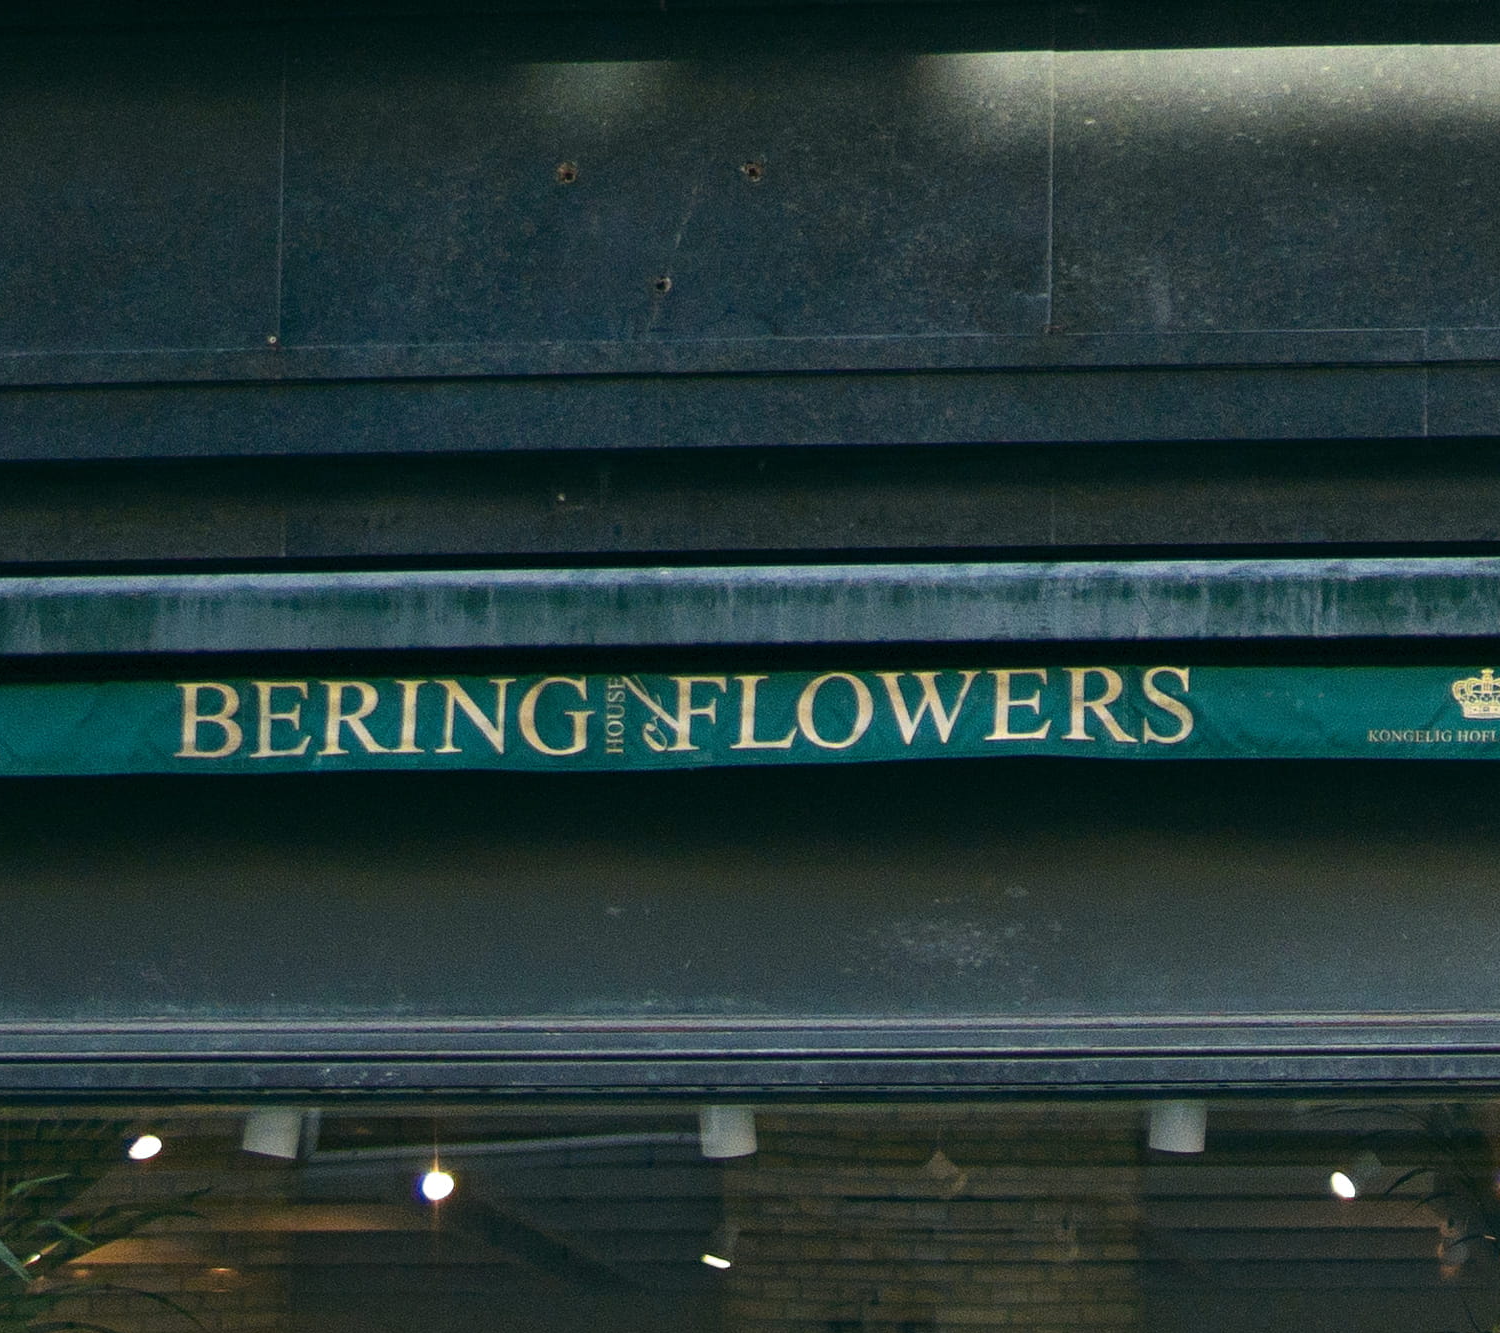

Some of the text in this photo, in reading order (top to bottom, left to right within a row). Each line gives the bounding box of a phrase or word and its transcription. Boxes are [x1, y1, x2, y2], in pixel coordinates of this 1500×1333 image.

[174, 676, 596, 758] BERING
[605, 676, 626, 754] HOUSE
[667, 666, 1193, 751] FLOWERS
[1368, 729, 1453, 744] KONGELIG
